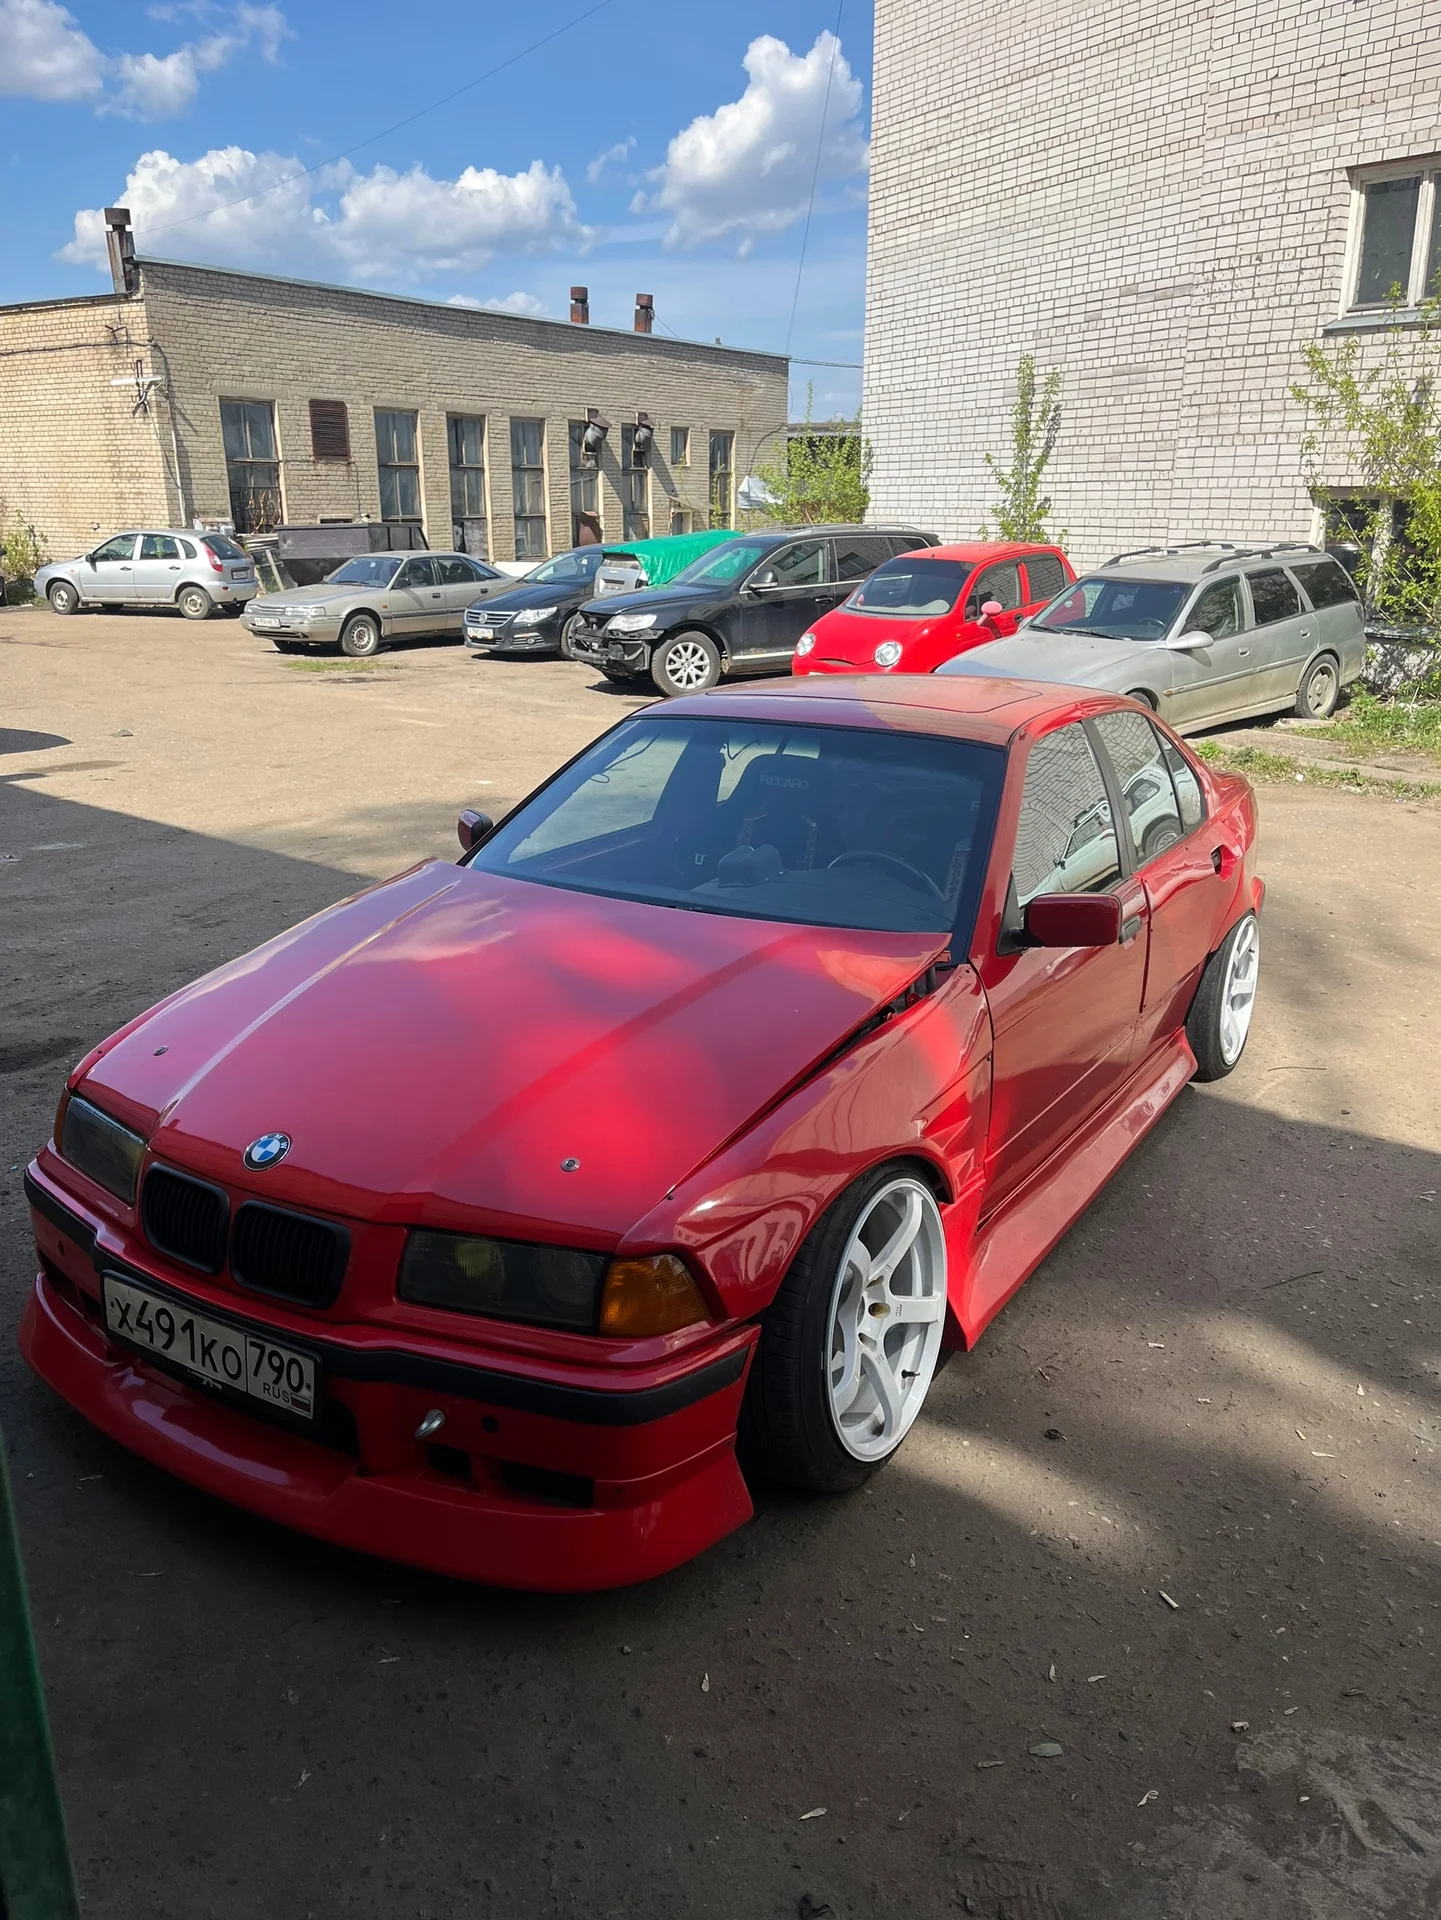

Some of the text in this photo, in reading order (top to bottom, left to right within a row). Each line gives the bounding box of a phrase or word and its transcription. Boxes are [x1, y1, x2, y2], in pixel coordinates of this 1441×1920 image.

[760, 774, 810, 790] RECARO
[249, 1341, 304, 1393] 790
[263, 1383, 290, 1404] RUS
